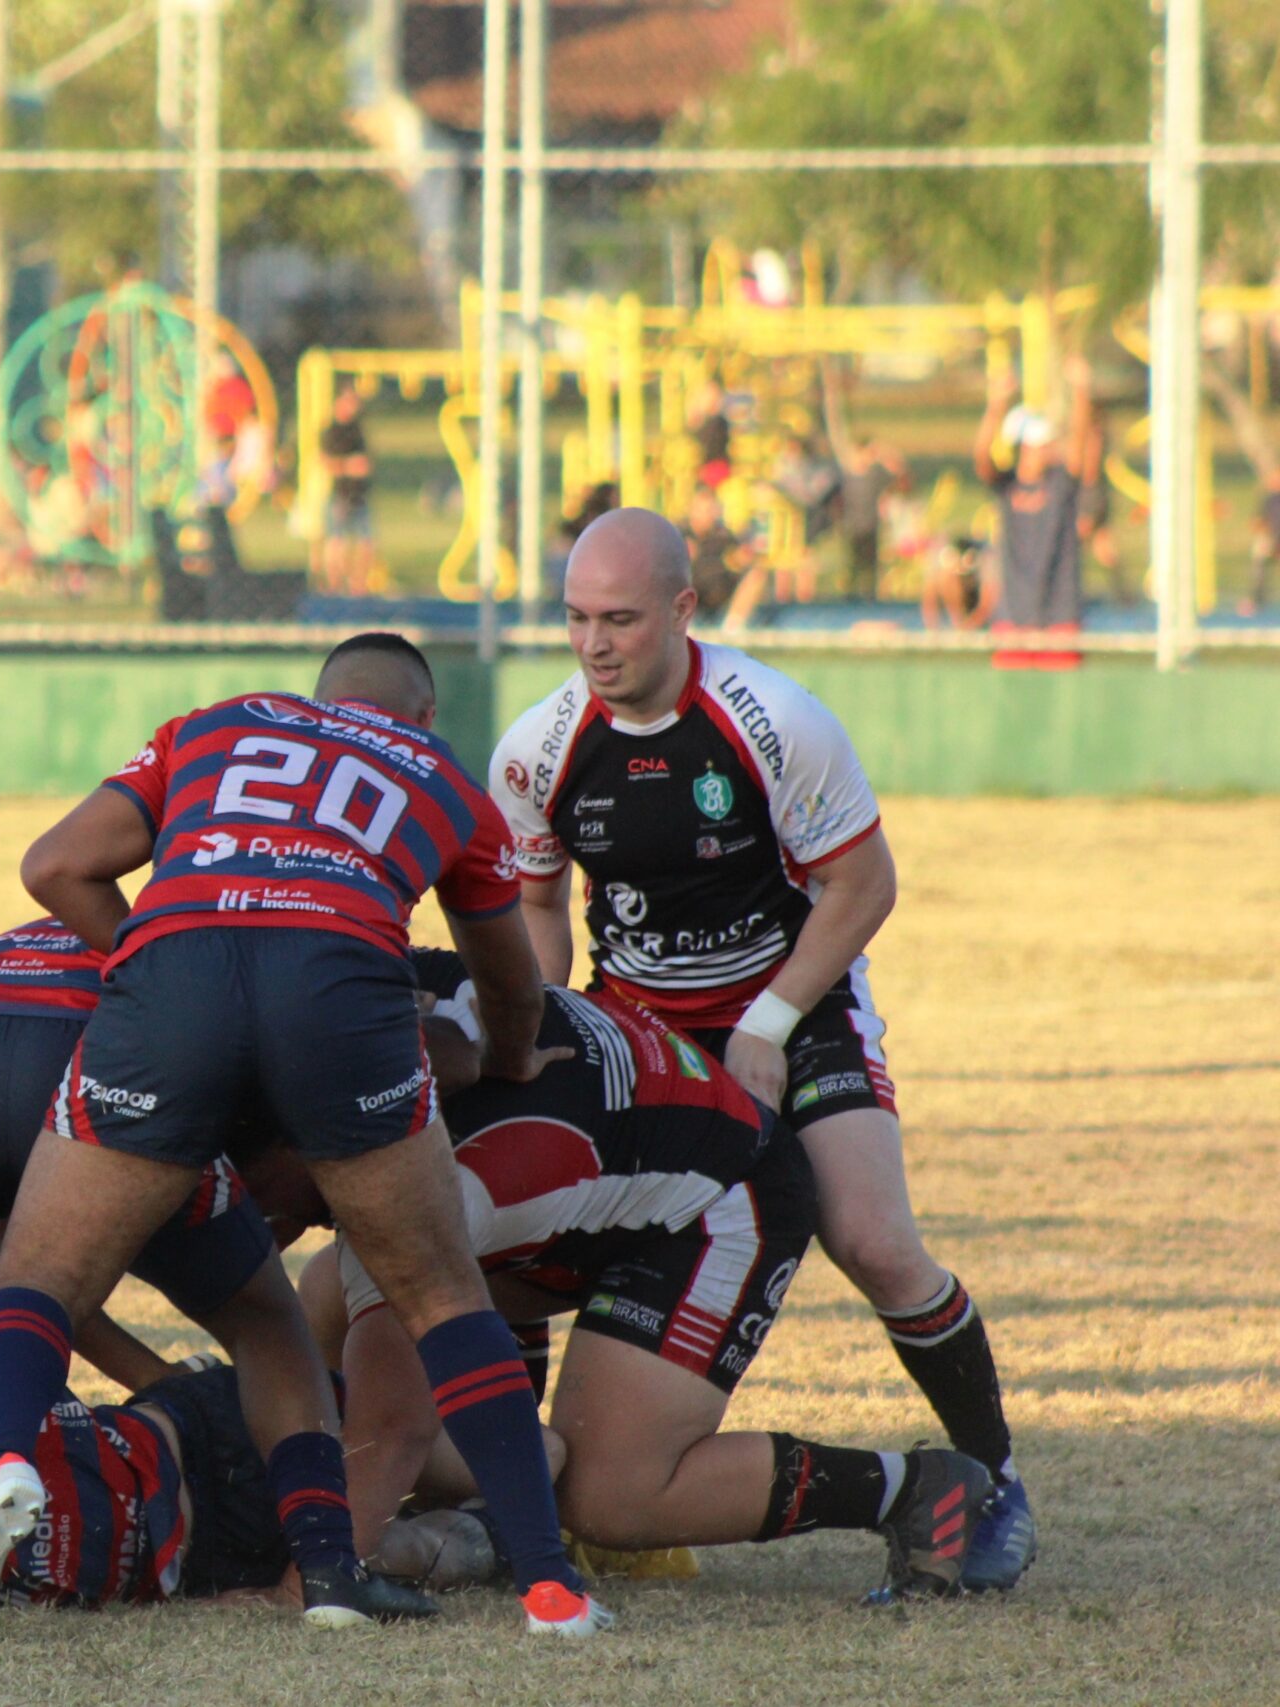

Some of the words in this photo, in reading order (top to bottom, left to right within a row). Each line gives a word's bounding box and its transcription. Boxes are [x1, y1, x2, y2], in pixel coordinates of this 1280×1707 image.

[542, 690, 577, 761] RioSP
[320, 718, 438, 771] VINAC
[628, 757, 668, 773] CNA
[213, 736, 407, 856] 20
[90, 1083, 158, 1111] SICOOB
[820, 1077, 869, 1096] BRASIL
[612, 1303, 661, 1333] BRASIL
